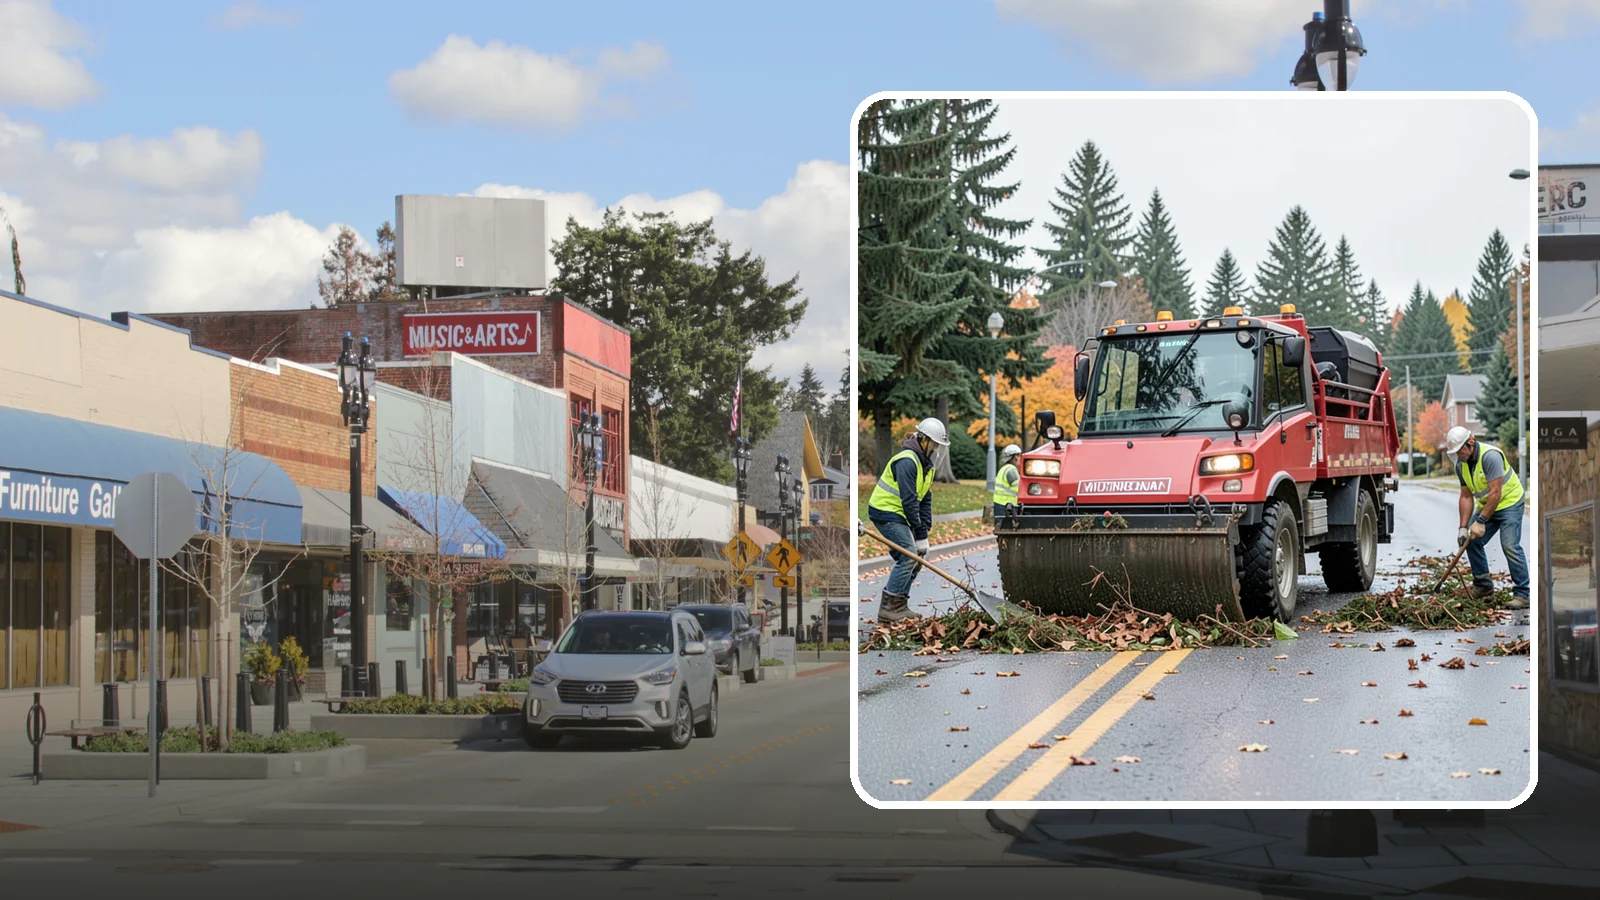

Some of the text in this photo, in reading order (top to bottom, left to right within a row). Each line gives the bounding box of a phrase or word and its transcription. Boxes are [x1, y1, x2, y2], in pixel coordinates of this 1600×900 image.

[0, 471, 121, 519] Furniture Gal
[453, 563, 479, 575] SUSHI
